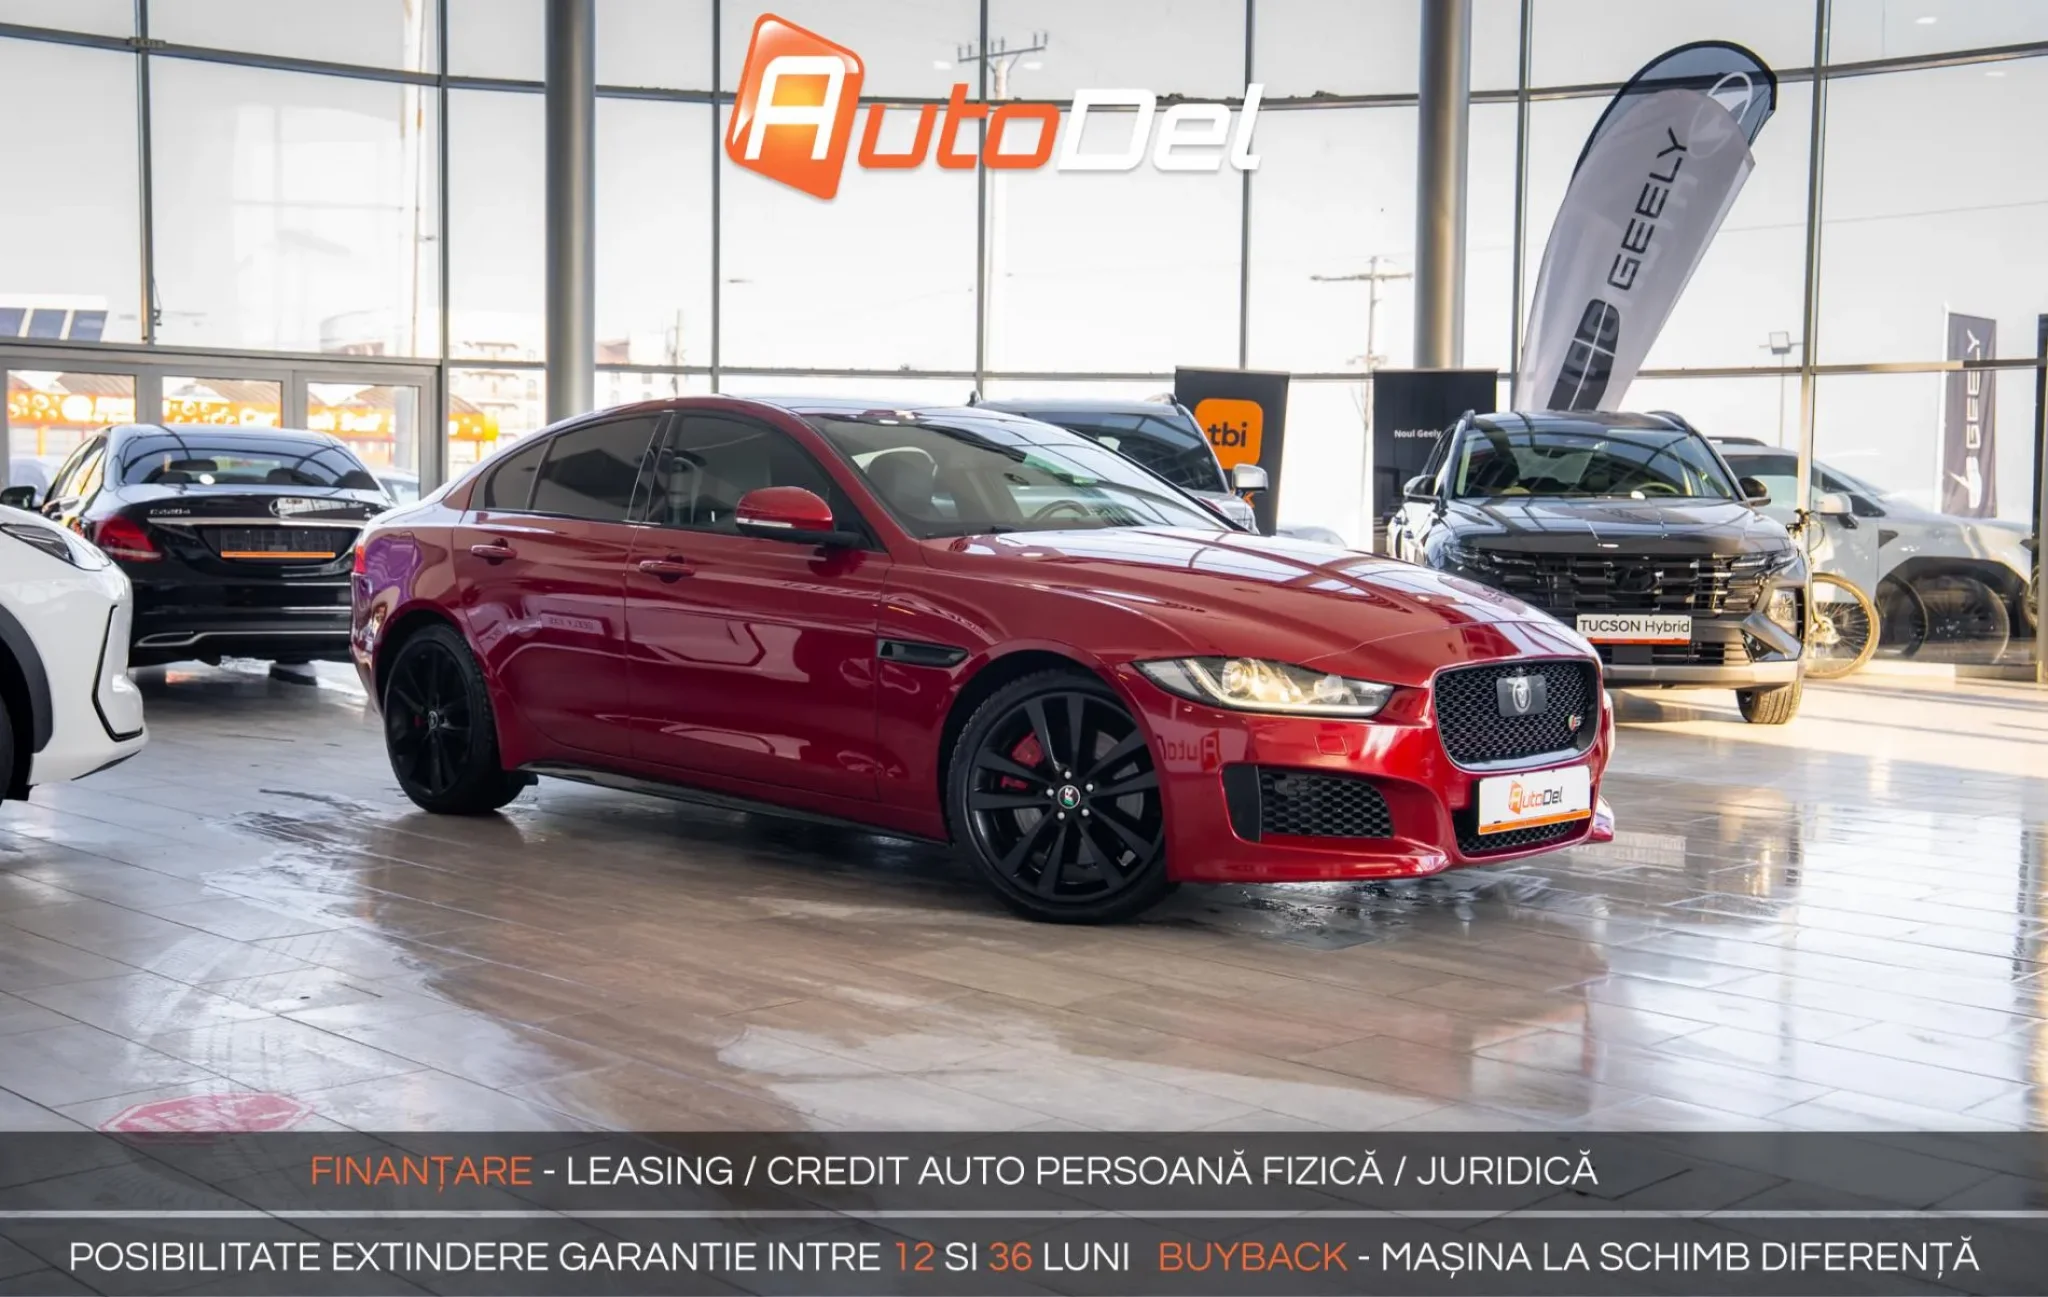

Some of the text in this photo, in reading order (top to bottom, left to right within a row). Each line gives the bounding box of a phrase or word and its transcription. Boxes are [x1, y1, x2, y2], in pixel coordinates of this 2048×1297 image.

[1607, 126, 1688, 290] GEELY
[1207, 421, 1248, 448] tbi
[1394, 429, 1442, 440] Noul Geely
[1580, 619, 1690, 635] TUCSON Hybrid
[1509, 785, 1563, 813] AutoDel
